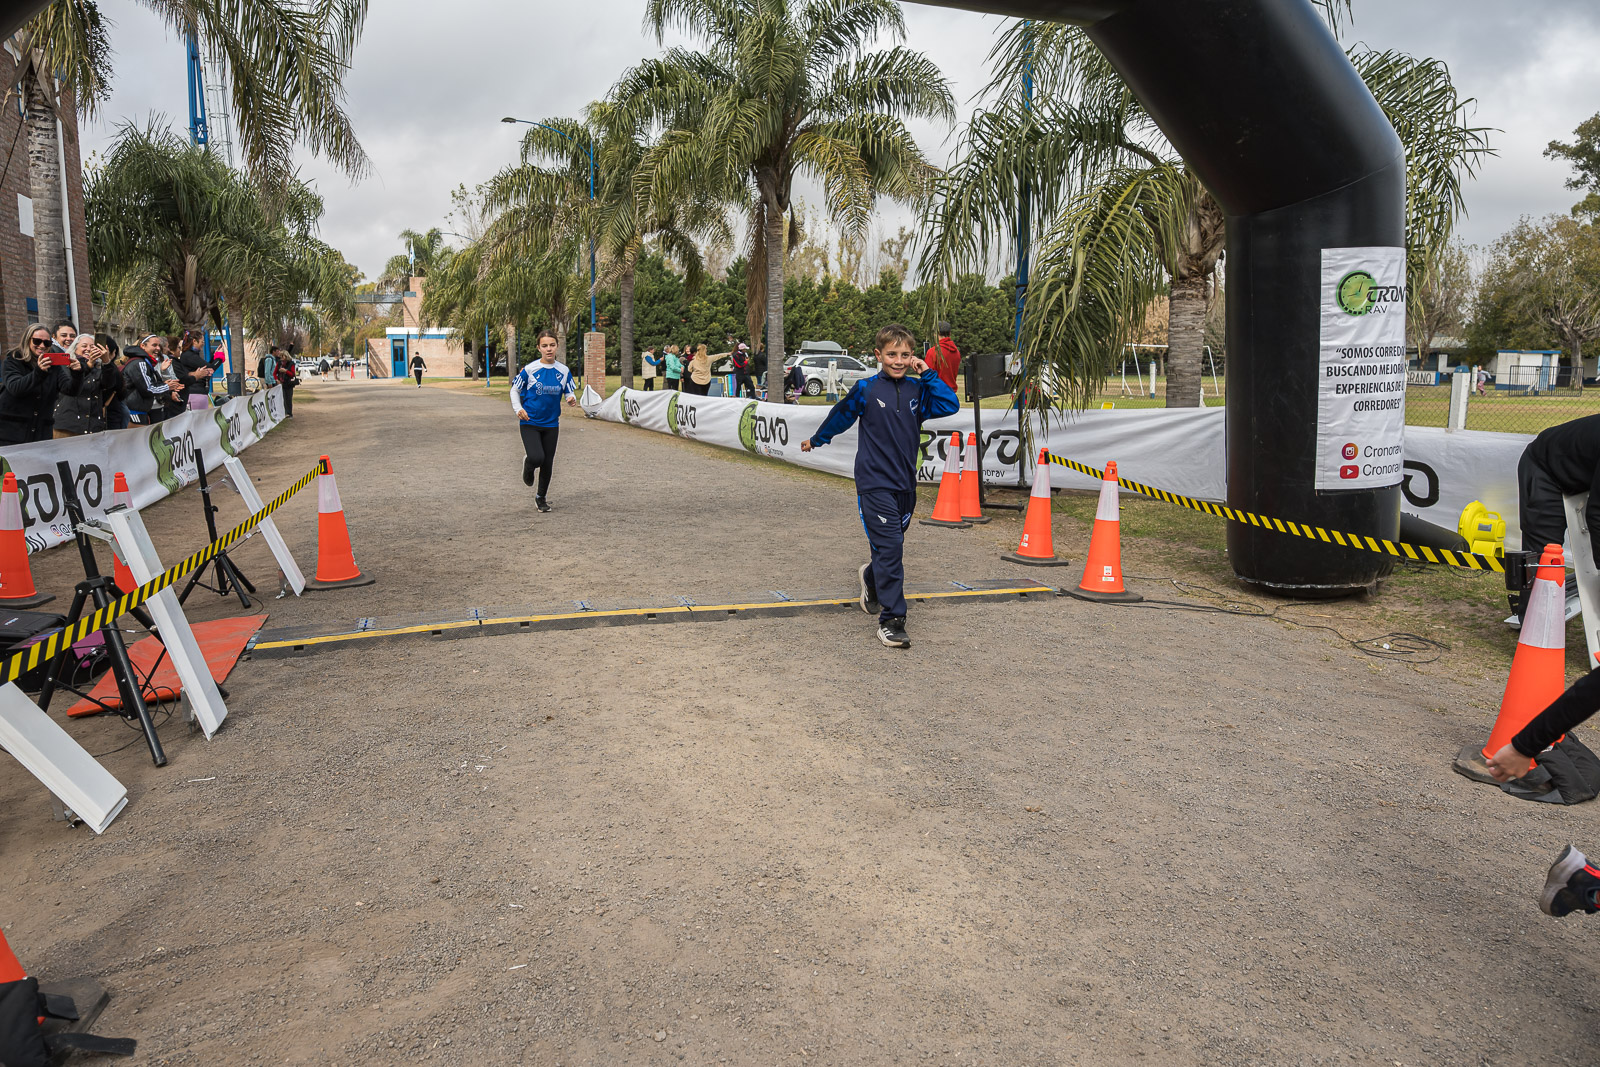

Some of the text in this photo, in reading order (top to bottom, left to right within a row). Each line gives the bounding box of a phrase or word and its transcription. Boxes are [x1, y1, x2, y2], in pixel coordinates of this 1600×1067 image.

[1366, 286, 1406, 303] CRON
[1365, 305, 1388, 314] RAV
[1326, 364, 1378, 377] BUSCANDO
[1335, 381, 1395, 395] EXPERIENCIAS
[918, 466, 936, 481] AV
